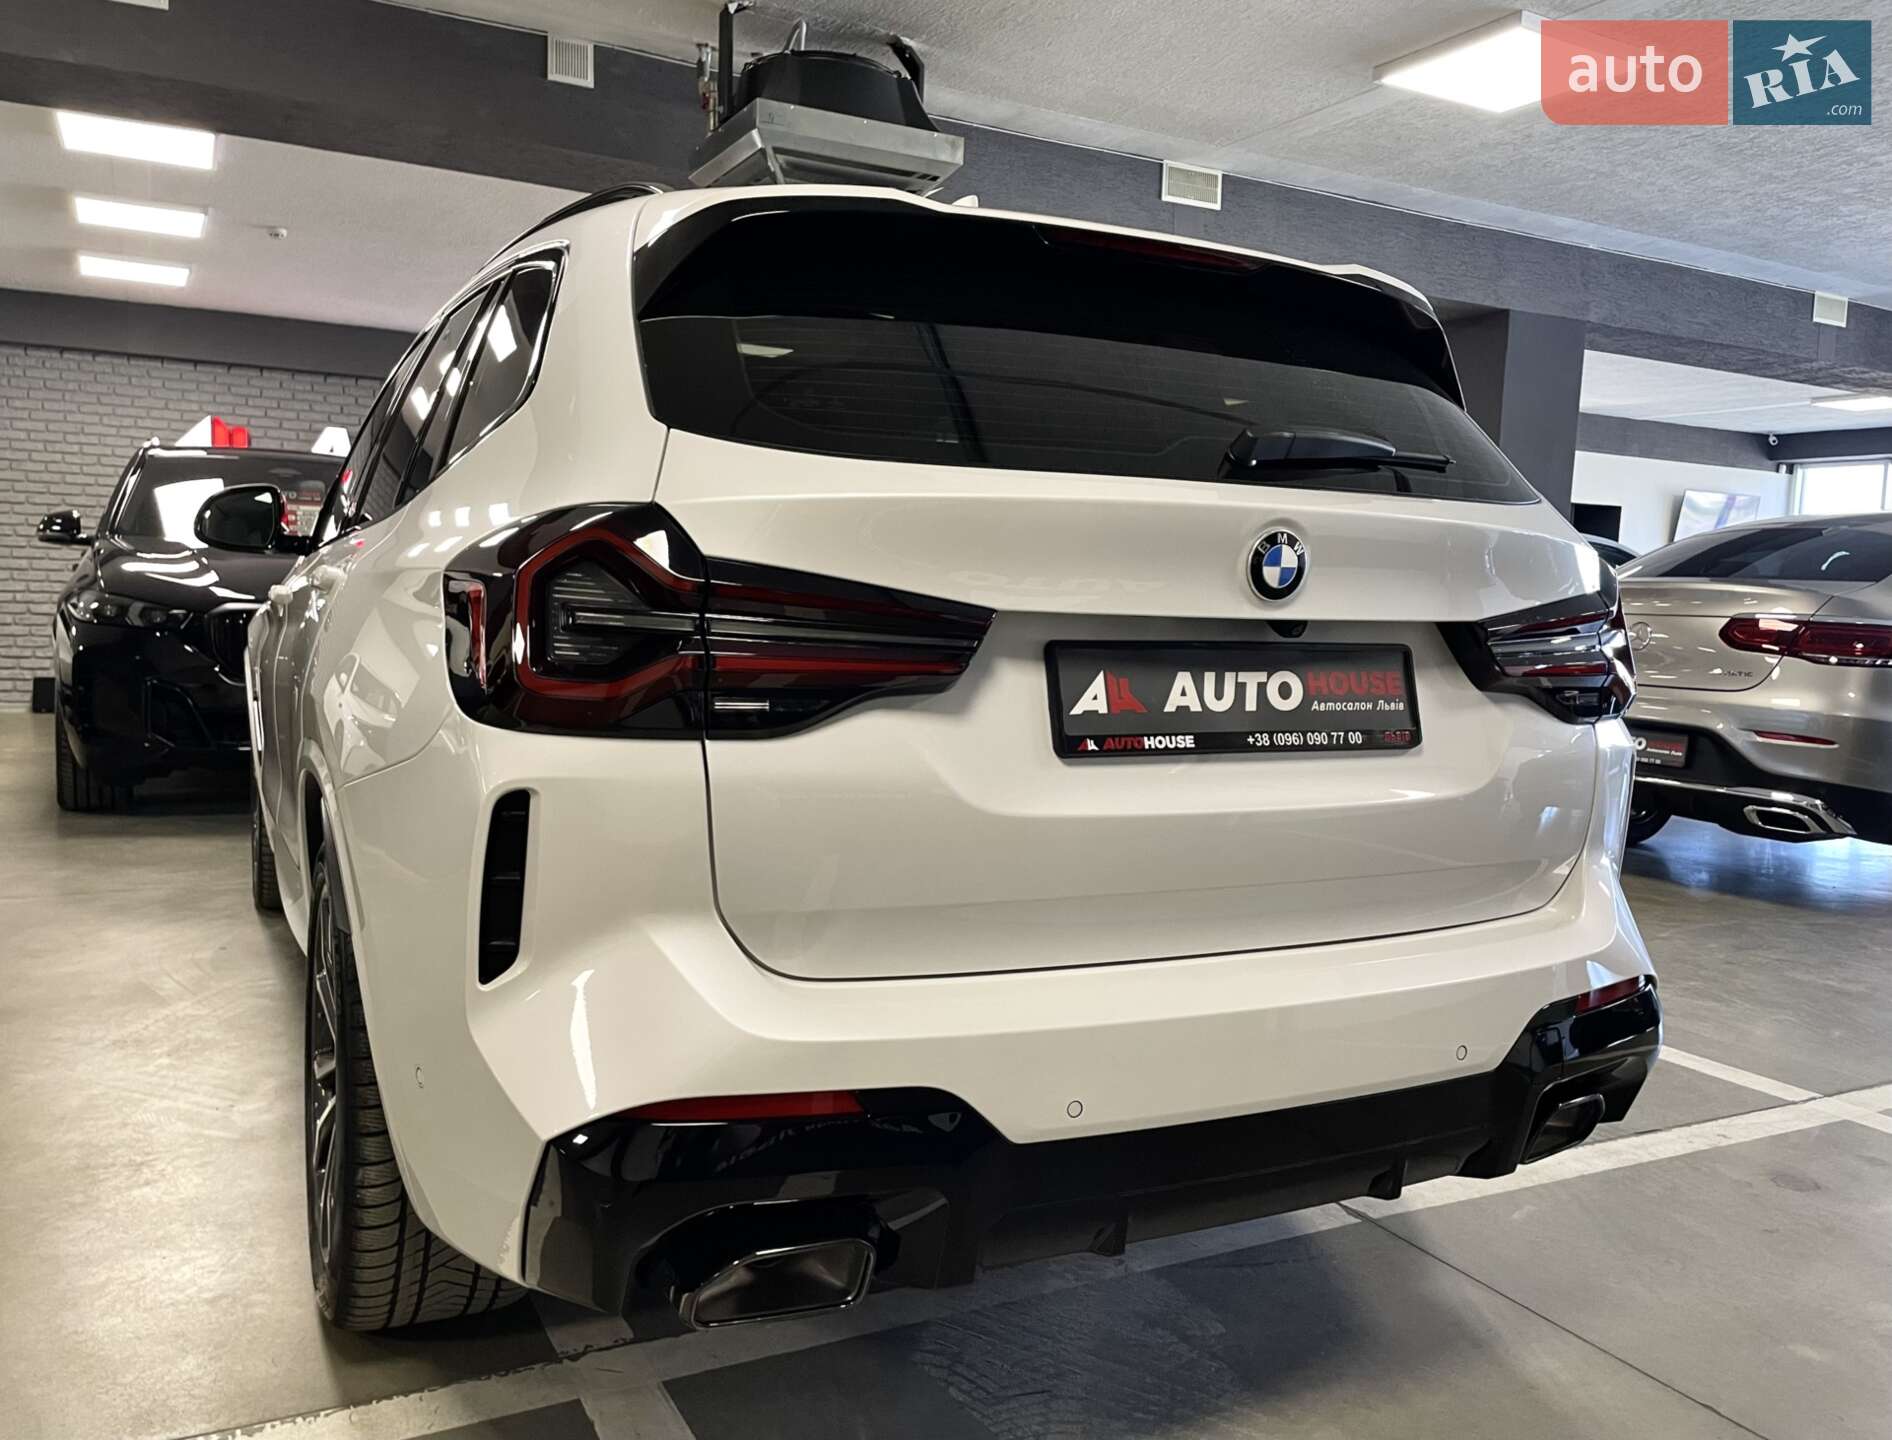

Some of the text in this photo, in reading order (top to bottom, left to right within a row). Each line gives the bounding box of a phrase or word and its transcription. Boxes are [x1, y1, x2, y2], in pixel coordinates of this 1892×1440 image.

[1257, 532, 1304, 556] BMW
[1163, 670, 1402, 713] AUTO HOUSE
[1311, 698, 1405, 712] Автосалон Львів
[1247, 731, 1363, 746] +38 (096) 090 77 00
